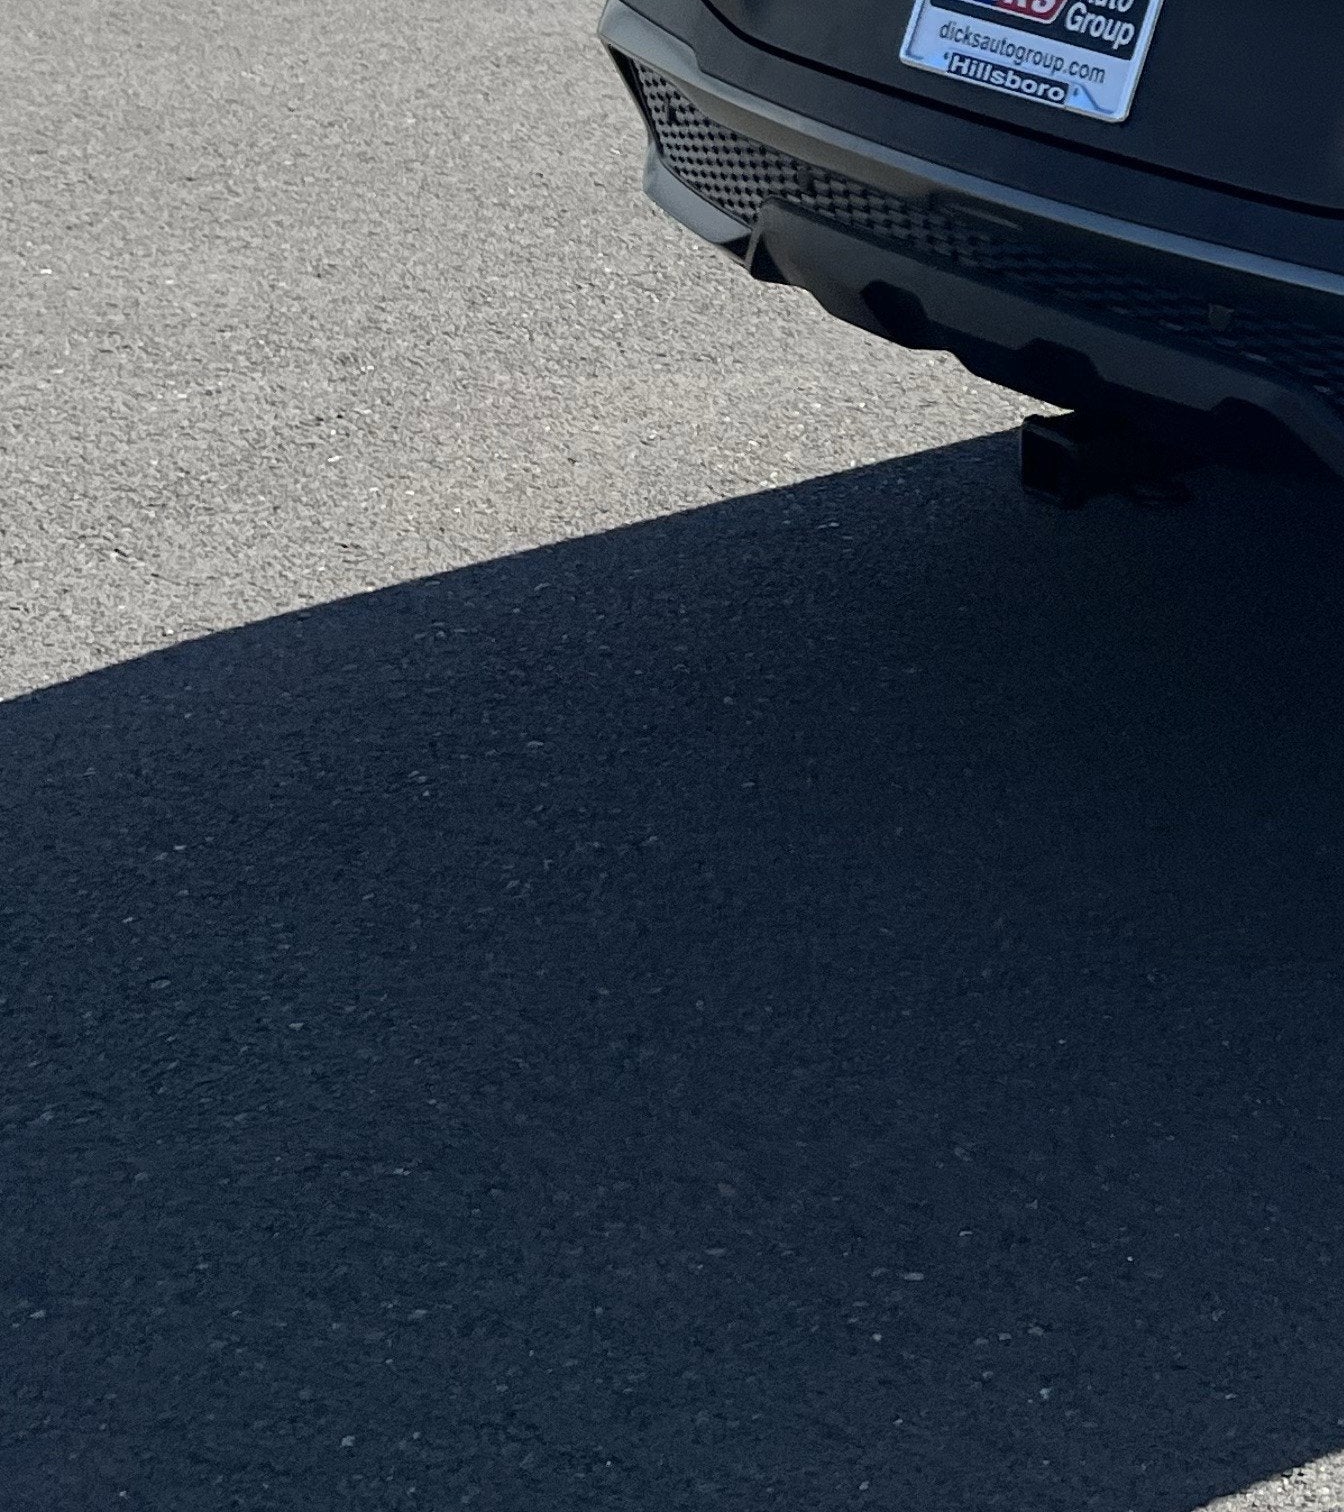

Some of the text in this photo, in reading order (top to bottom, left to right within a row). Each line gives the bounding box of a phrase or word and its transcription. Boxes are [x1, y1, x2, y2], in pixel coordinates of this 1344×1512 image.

[1064, 1, 1135, 50] Group
[939, 20, 1106, 85] dicksautogroup.com
[949, 55, 1066, 104] Hillsboro
